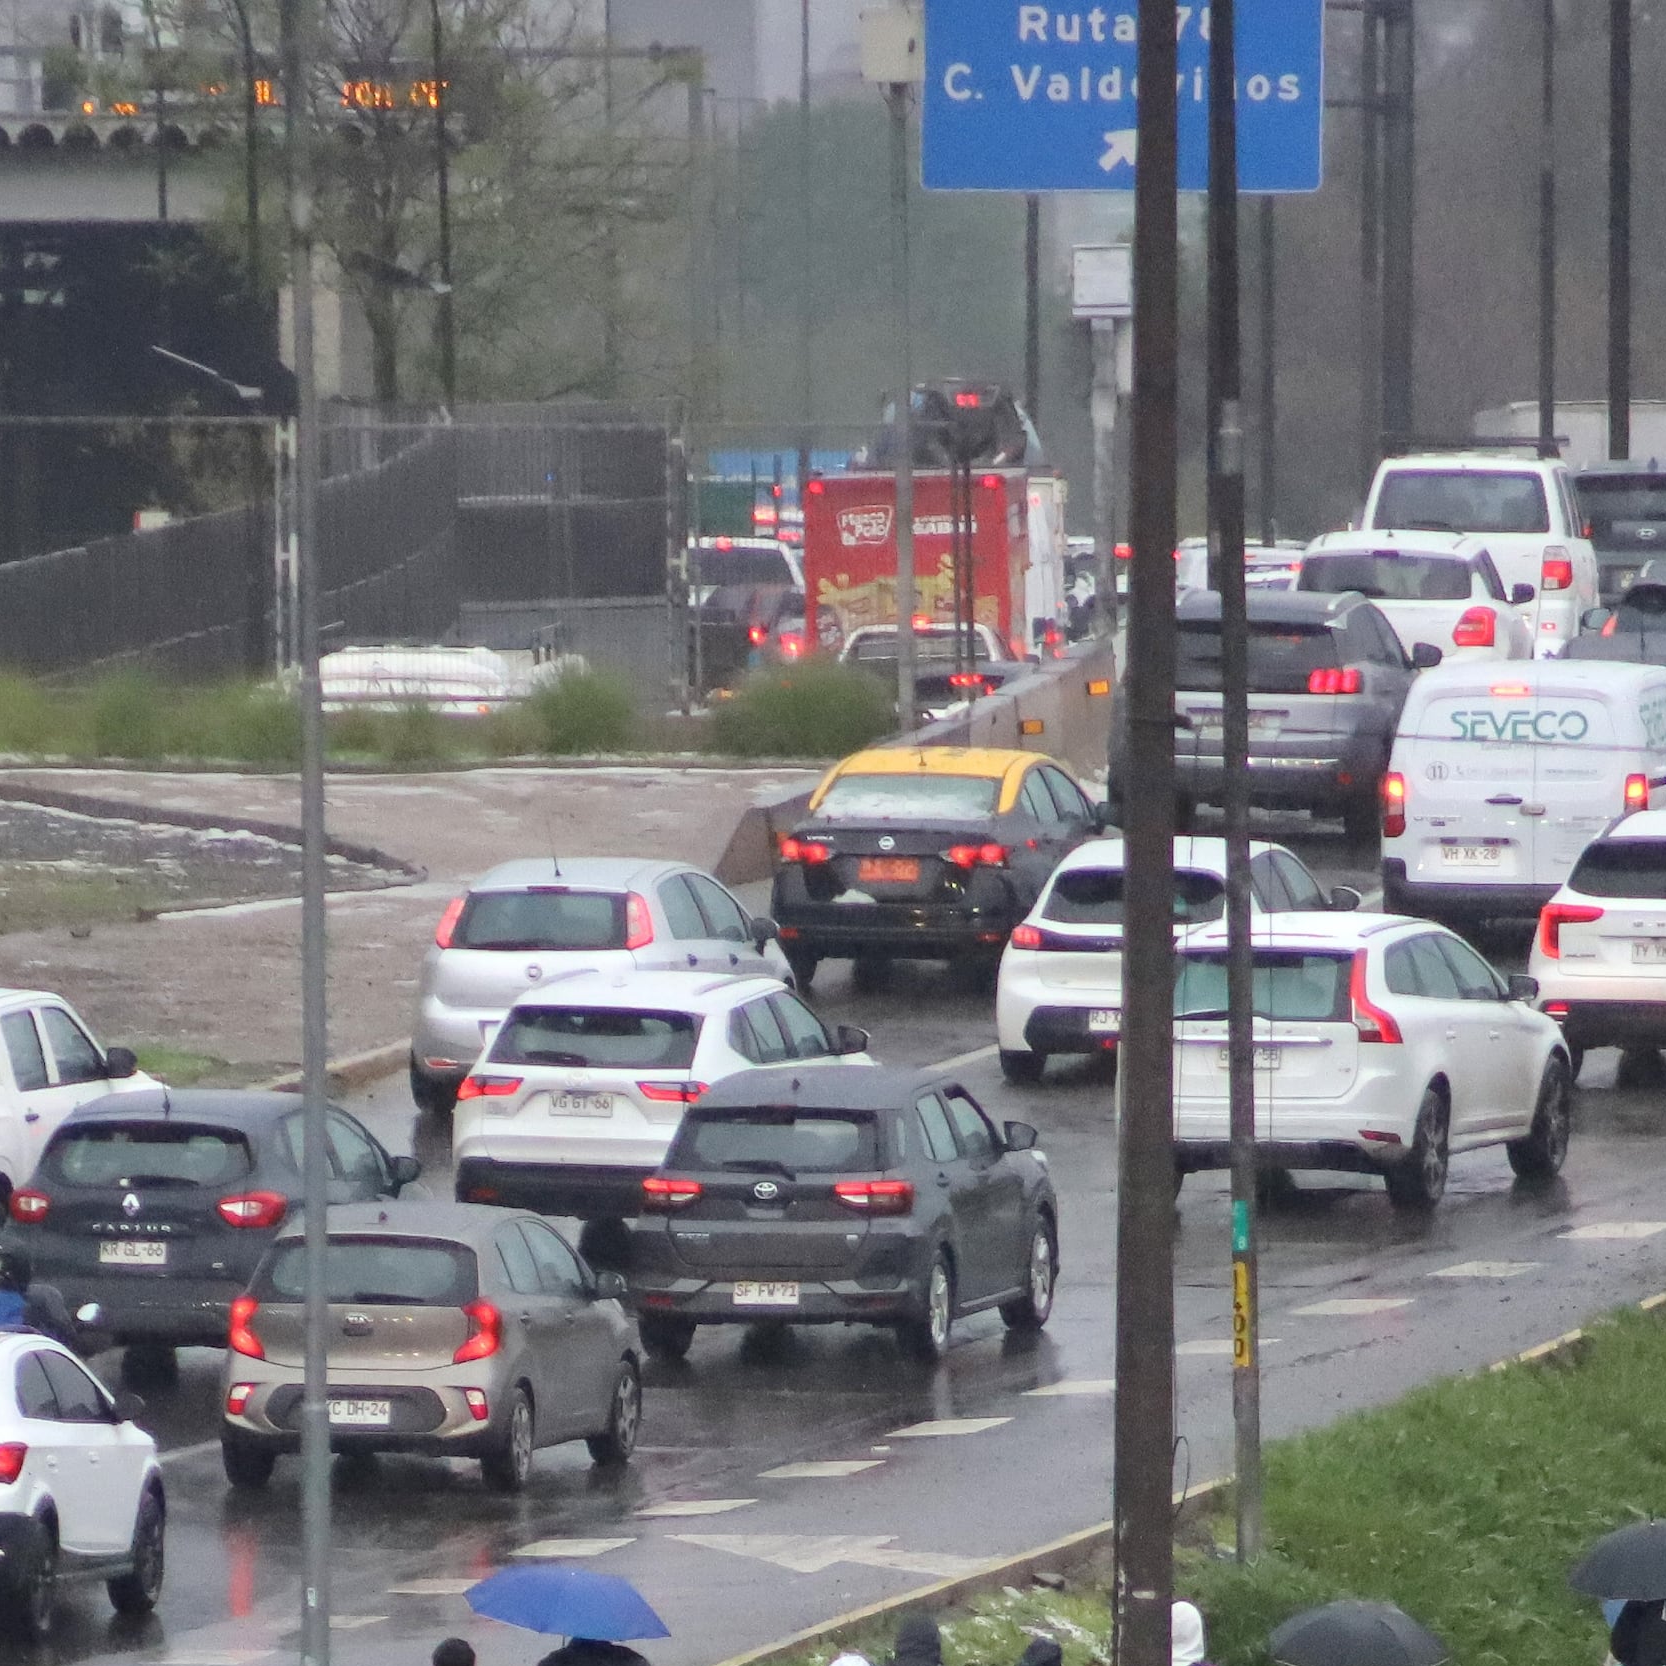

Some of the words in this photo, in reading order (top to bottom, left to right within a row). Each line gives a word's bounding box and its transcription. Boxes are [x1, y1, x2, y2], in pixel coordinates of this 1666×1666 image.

[1020, 5, 1137, 42] Ruta
[944, 63, 984, 100] C.
[1451, 710, 1588, 741] SEVECO
